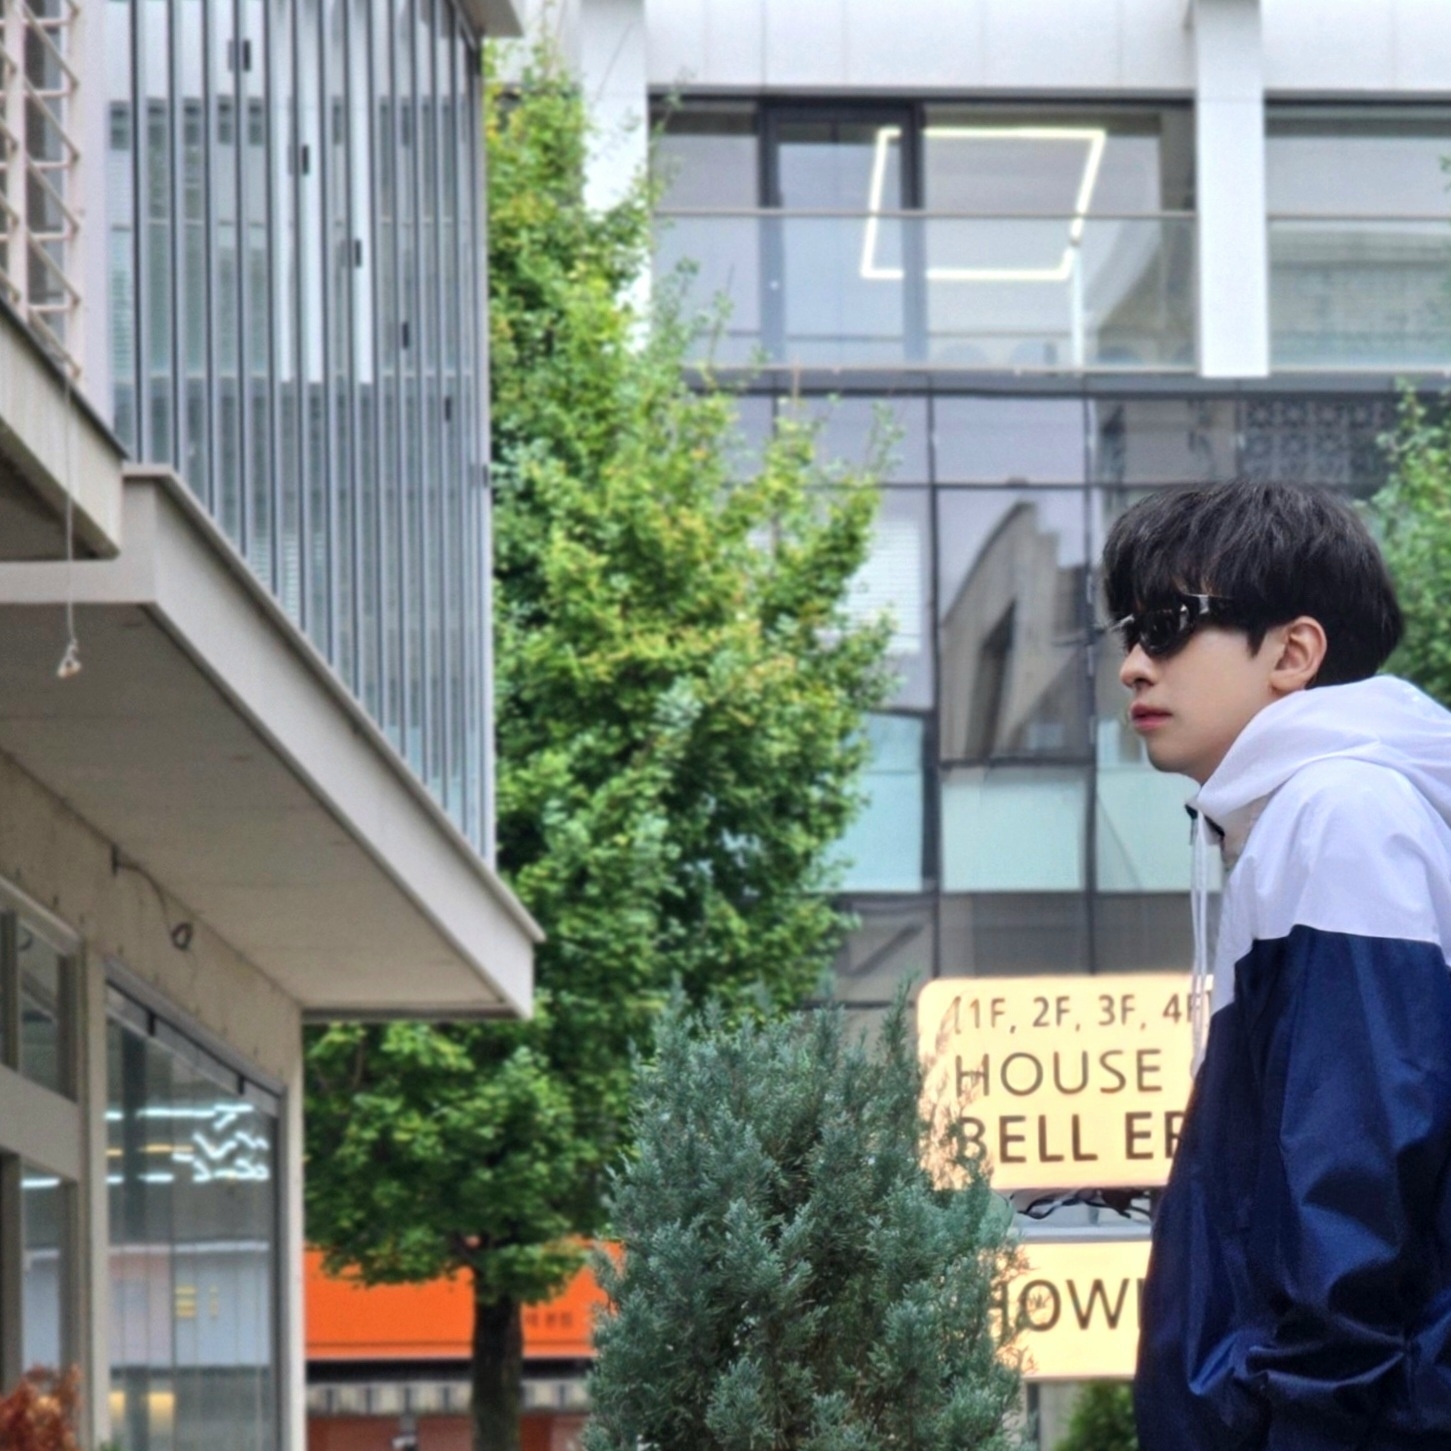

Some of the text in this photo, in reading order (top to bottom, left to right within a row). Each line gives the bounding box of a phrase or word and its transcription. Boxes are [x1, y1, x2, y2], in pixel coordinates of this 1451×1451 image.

[954, 1048, 1163, 1098] HOUSE
[957, 1113, 1099, 1164] BELL
[982, 1277, 1146, 1333] HOW
